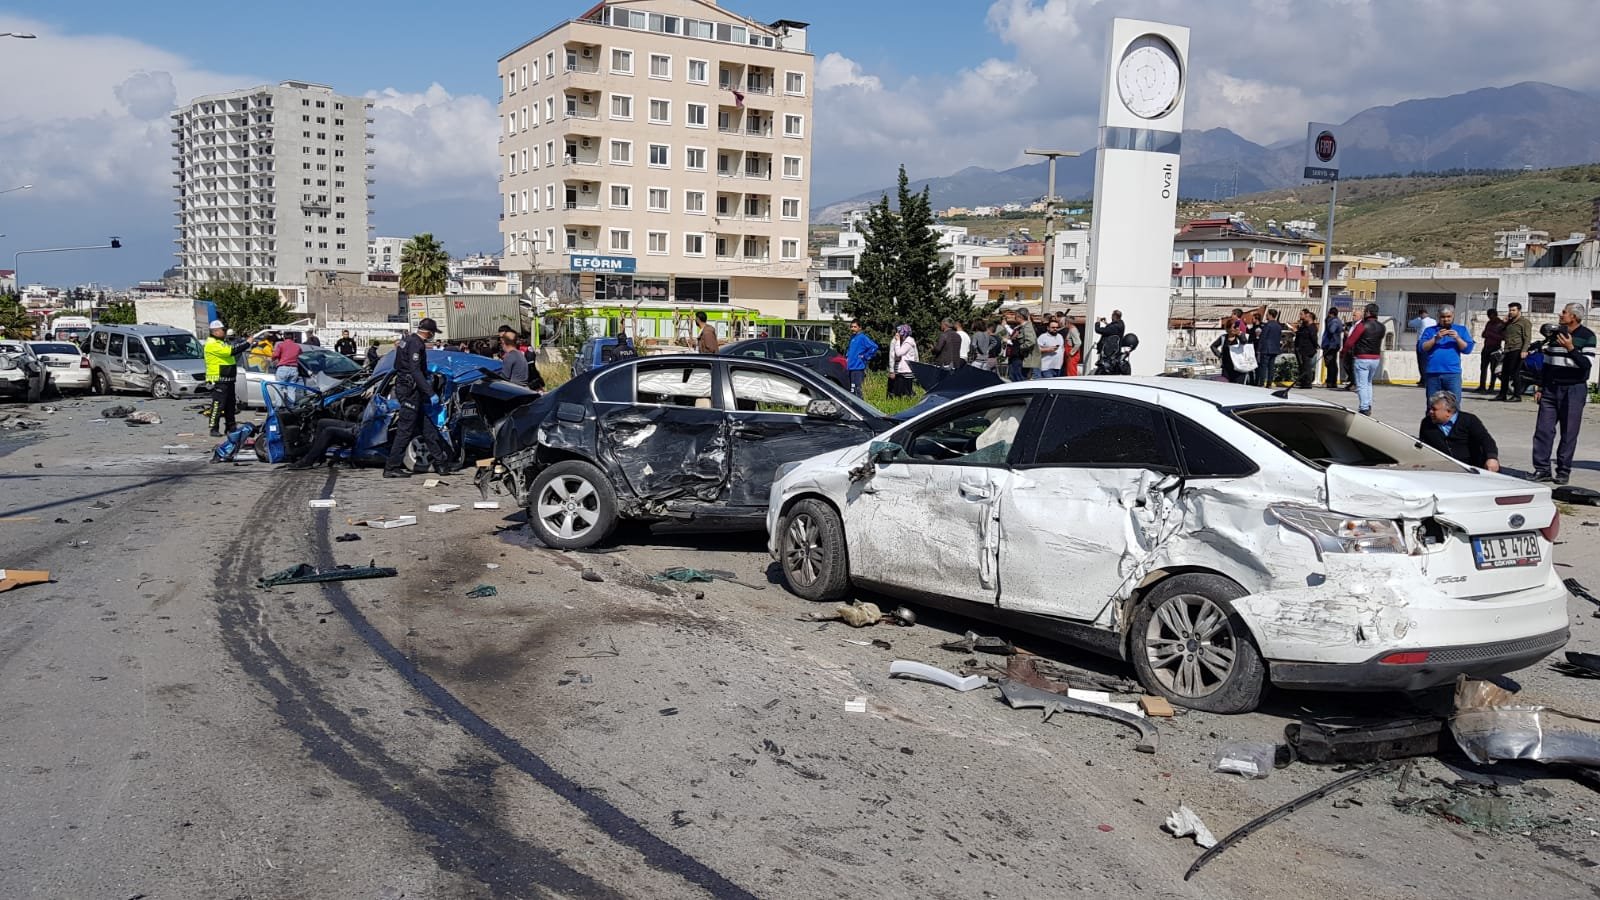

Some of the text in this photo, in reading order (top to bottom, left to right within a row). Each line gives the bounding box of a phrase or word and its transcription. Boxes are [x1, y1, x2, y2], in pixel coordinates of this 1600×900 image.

[1483, 536, 1538, 560] 31 B 4728
